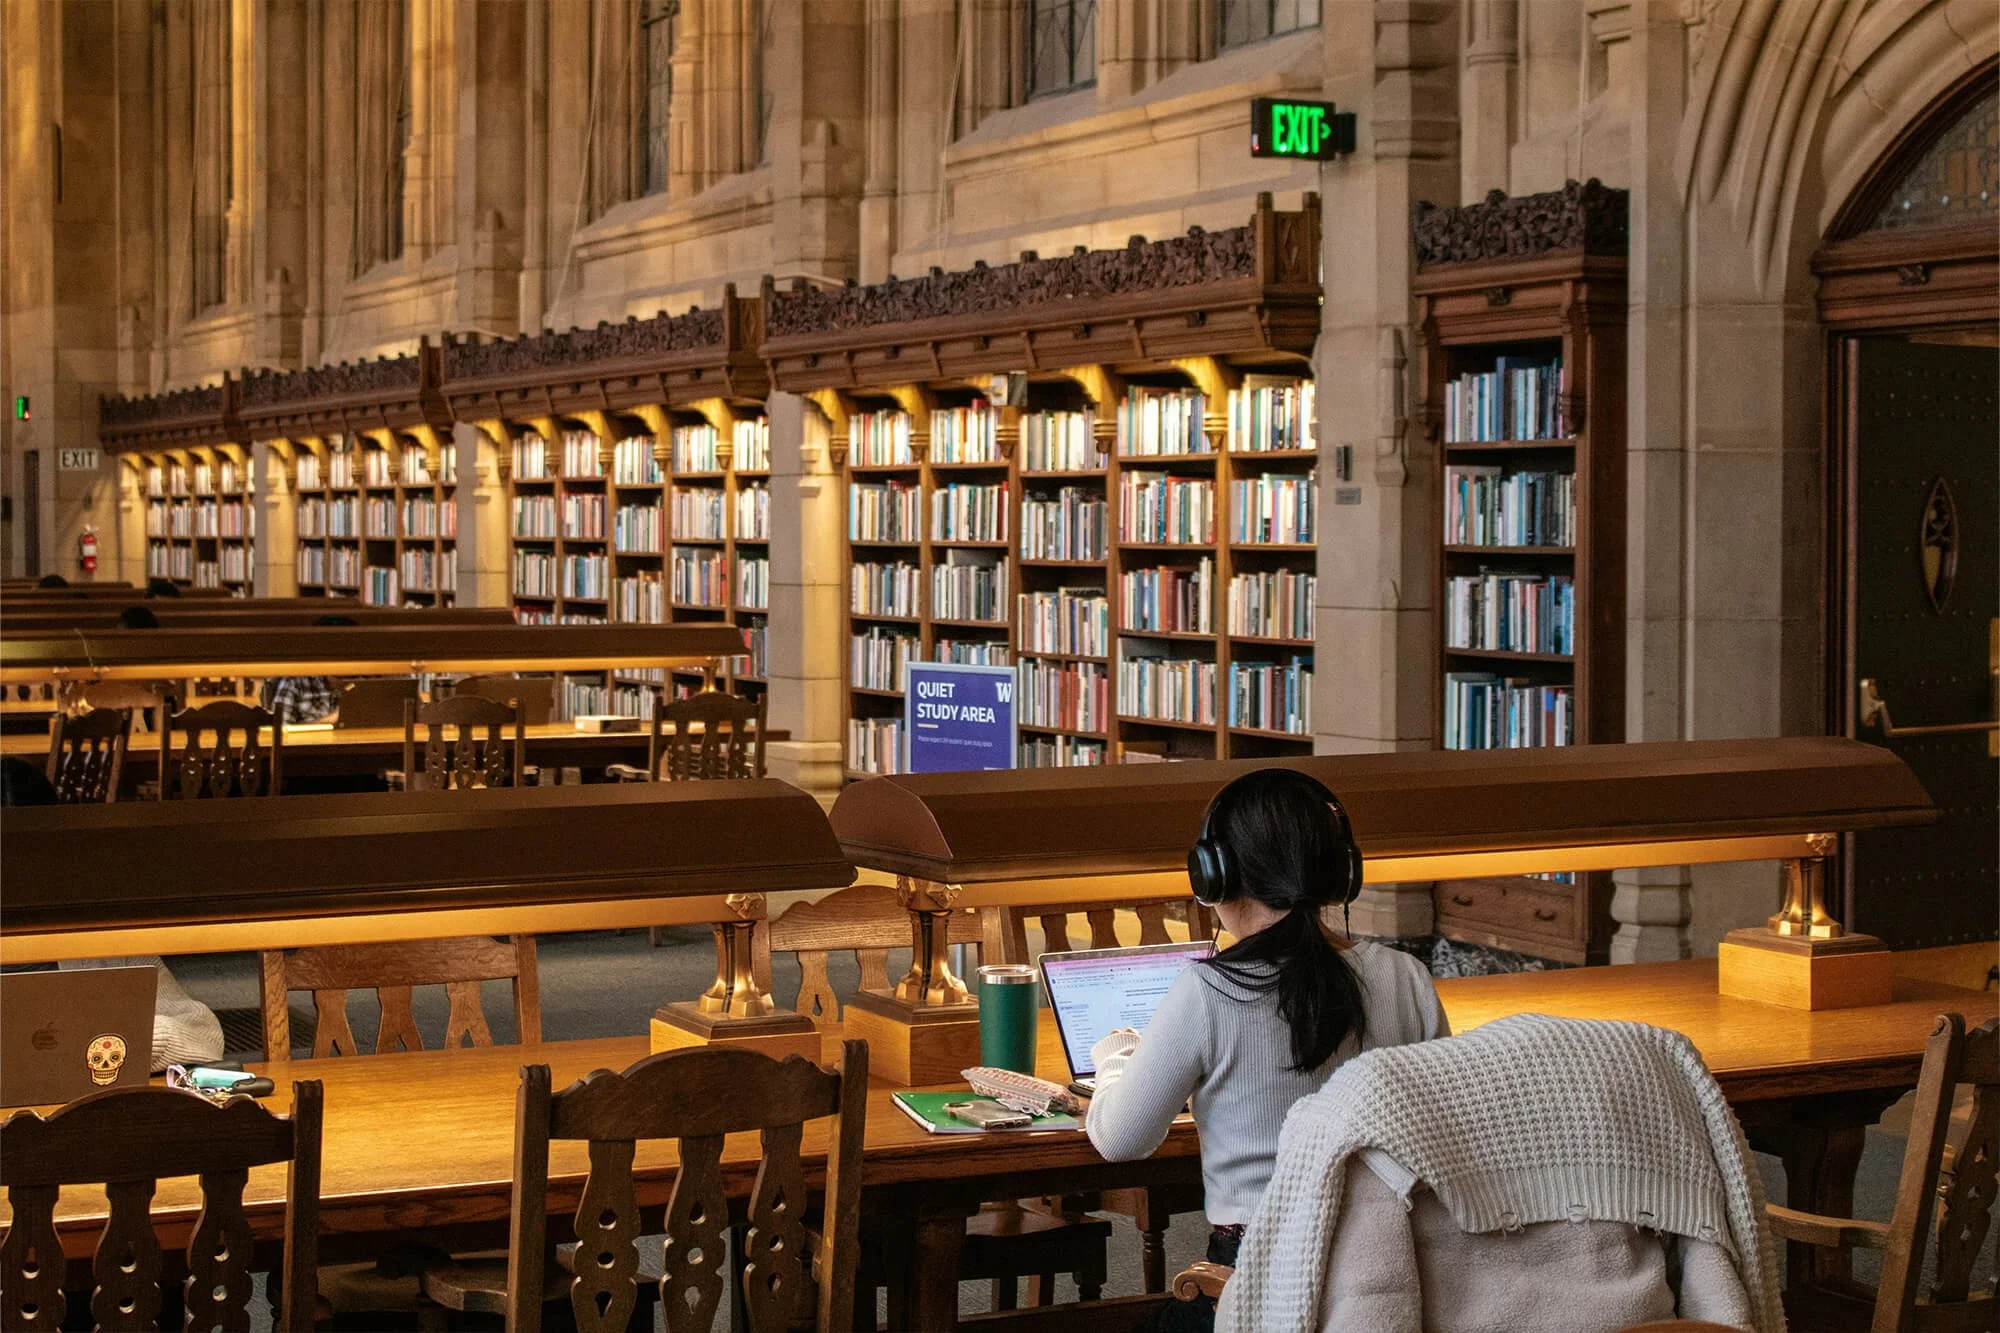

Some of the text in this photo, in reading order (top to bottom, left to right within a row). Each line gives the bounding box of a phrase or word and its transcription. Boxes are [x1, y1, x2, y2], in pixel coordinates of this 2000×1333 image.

[1271, 103, 1325, 154] EXIT
[61, 451, 93, 468] EXIT
[917, 681, 956, 699] QUIET
[995, 682, 1012, 703] W
[917, 703, 996, 723] STUDY AREA
